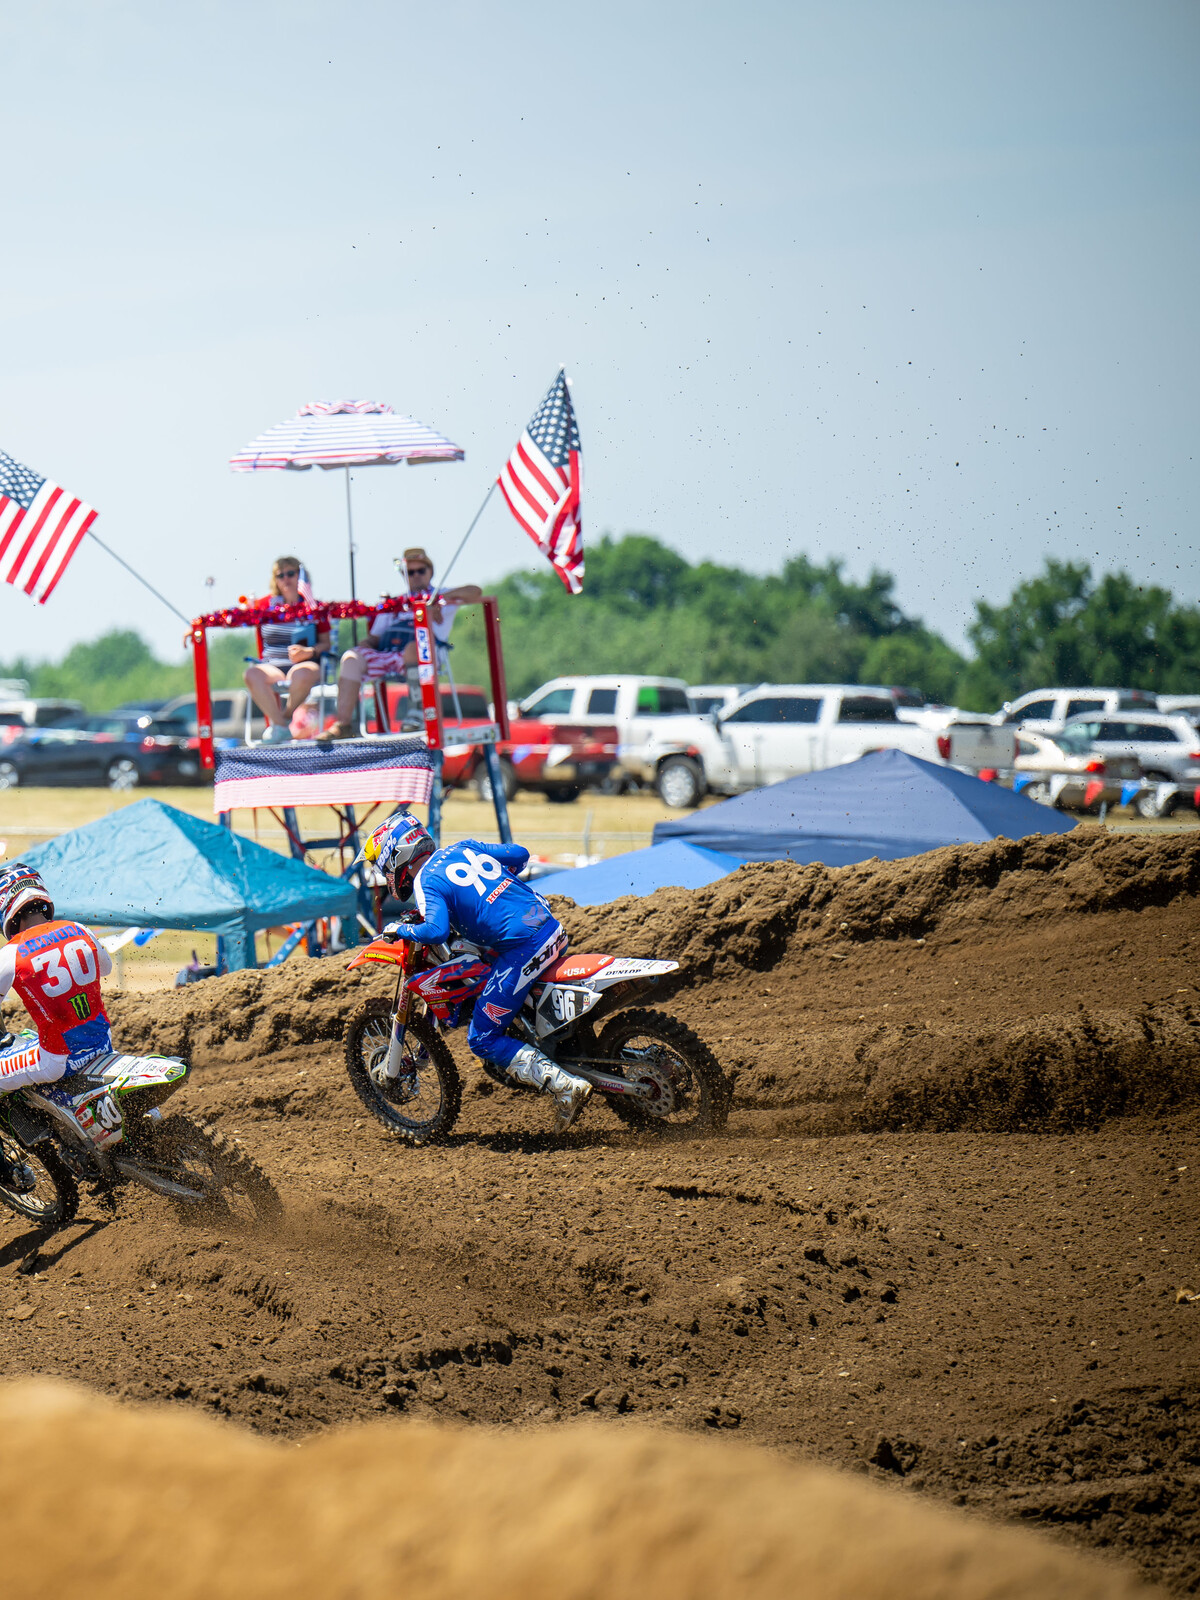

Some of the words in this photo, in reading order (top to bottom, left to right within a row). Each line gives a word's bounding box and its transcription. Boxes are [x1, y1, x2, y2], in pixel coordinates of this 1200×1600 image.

[445, 848, 502, 897] 96
[486, 878, 514, 904] HONDA
[17, 925, 86, 958] SHIMODA
[31, 939, 97, 997] 30
[567, 968, 586, 977] USA
[605, 969, 642, 977] DUNLOP
[421, 986, 449, 998] HONDA
[552, 990, 576, 1021] 96
[96, 1096, 122, 1129] 30
